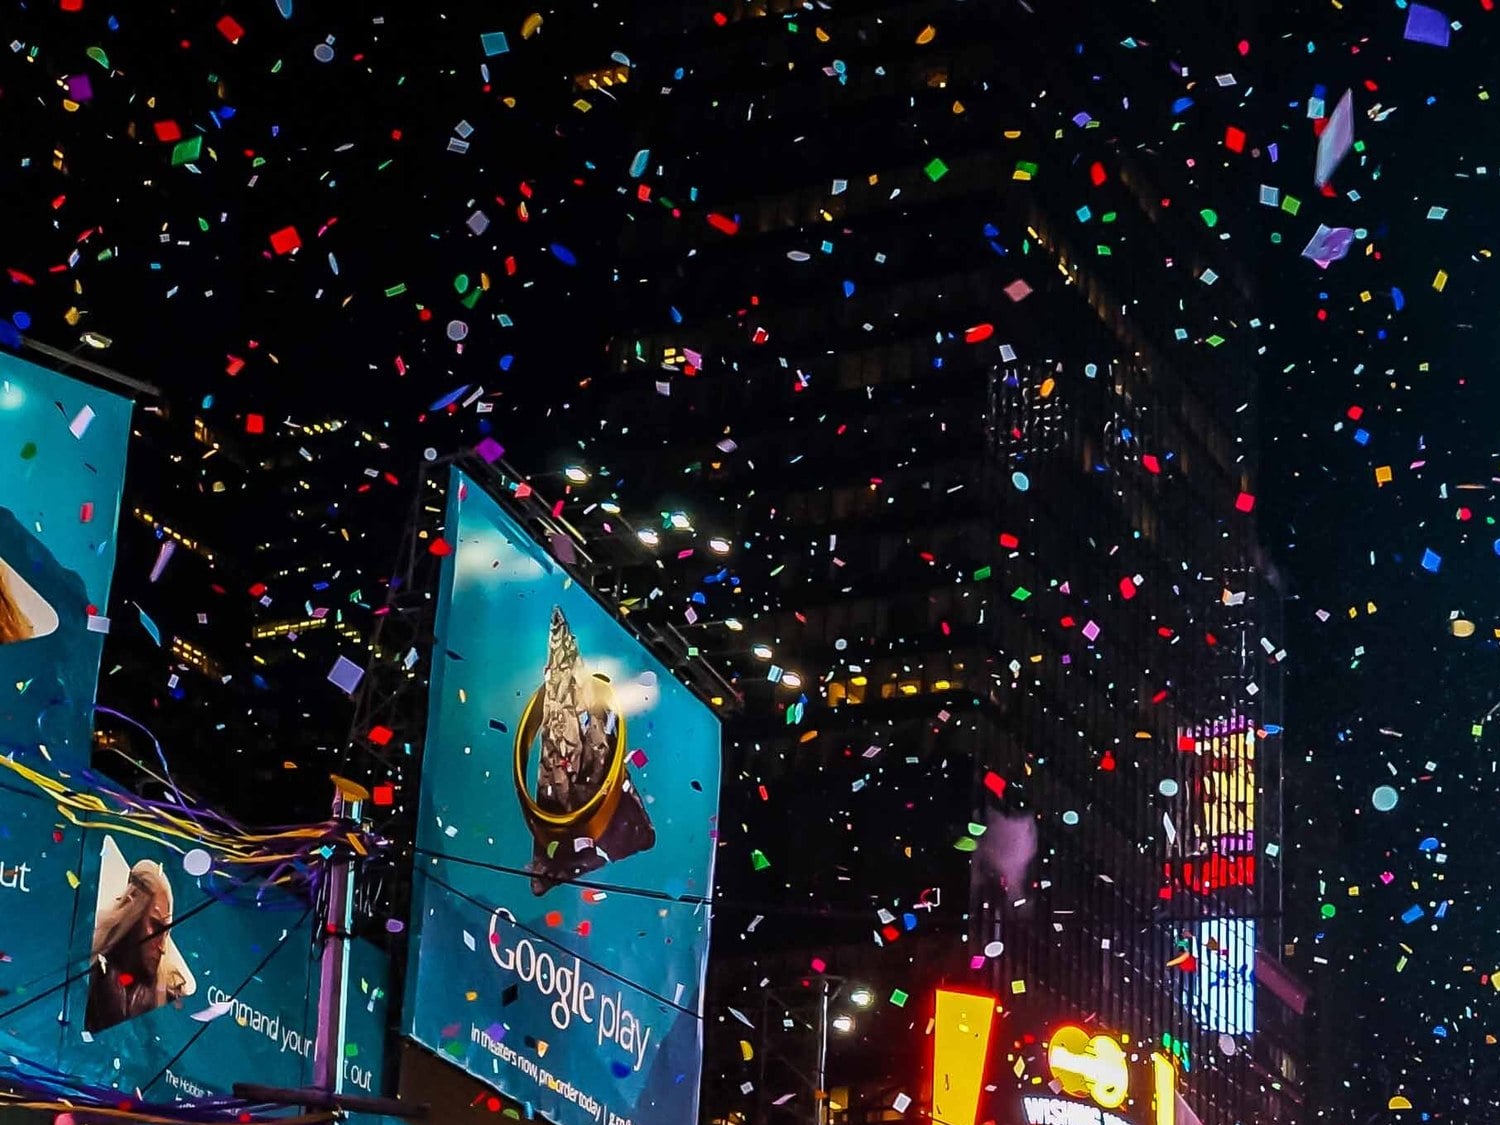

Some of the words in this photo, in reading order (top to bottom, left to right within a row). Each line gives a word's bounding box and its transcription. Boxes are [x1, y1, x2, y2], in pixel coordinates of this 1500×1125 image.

[489, 907, 595, 1030] Google
[599, 991, 651, 1071] play
[281, 1025, 313, 1060] your
[351, 1064, 372, 1093] out
